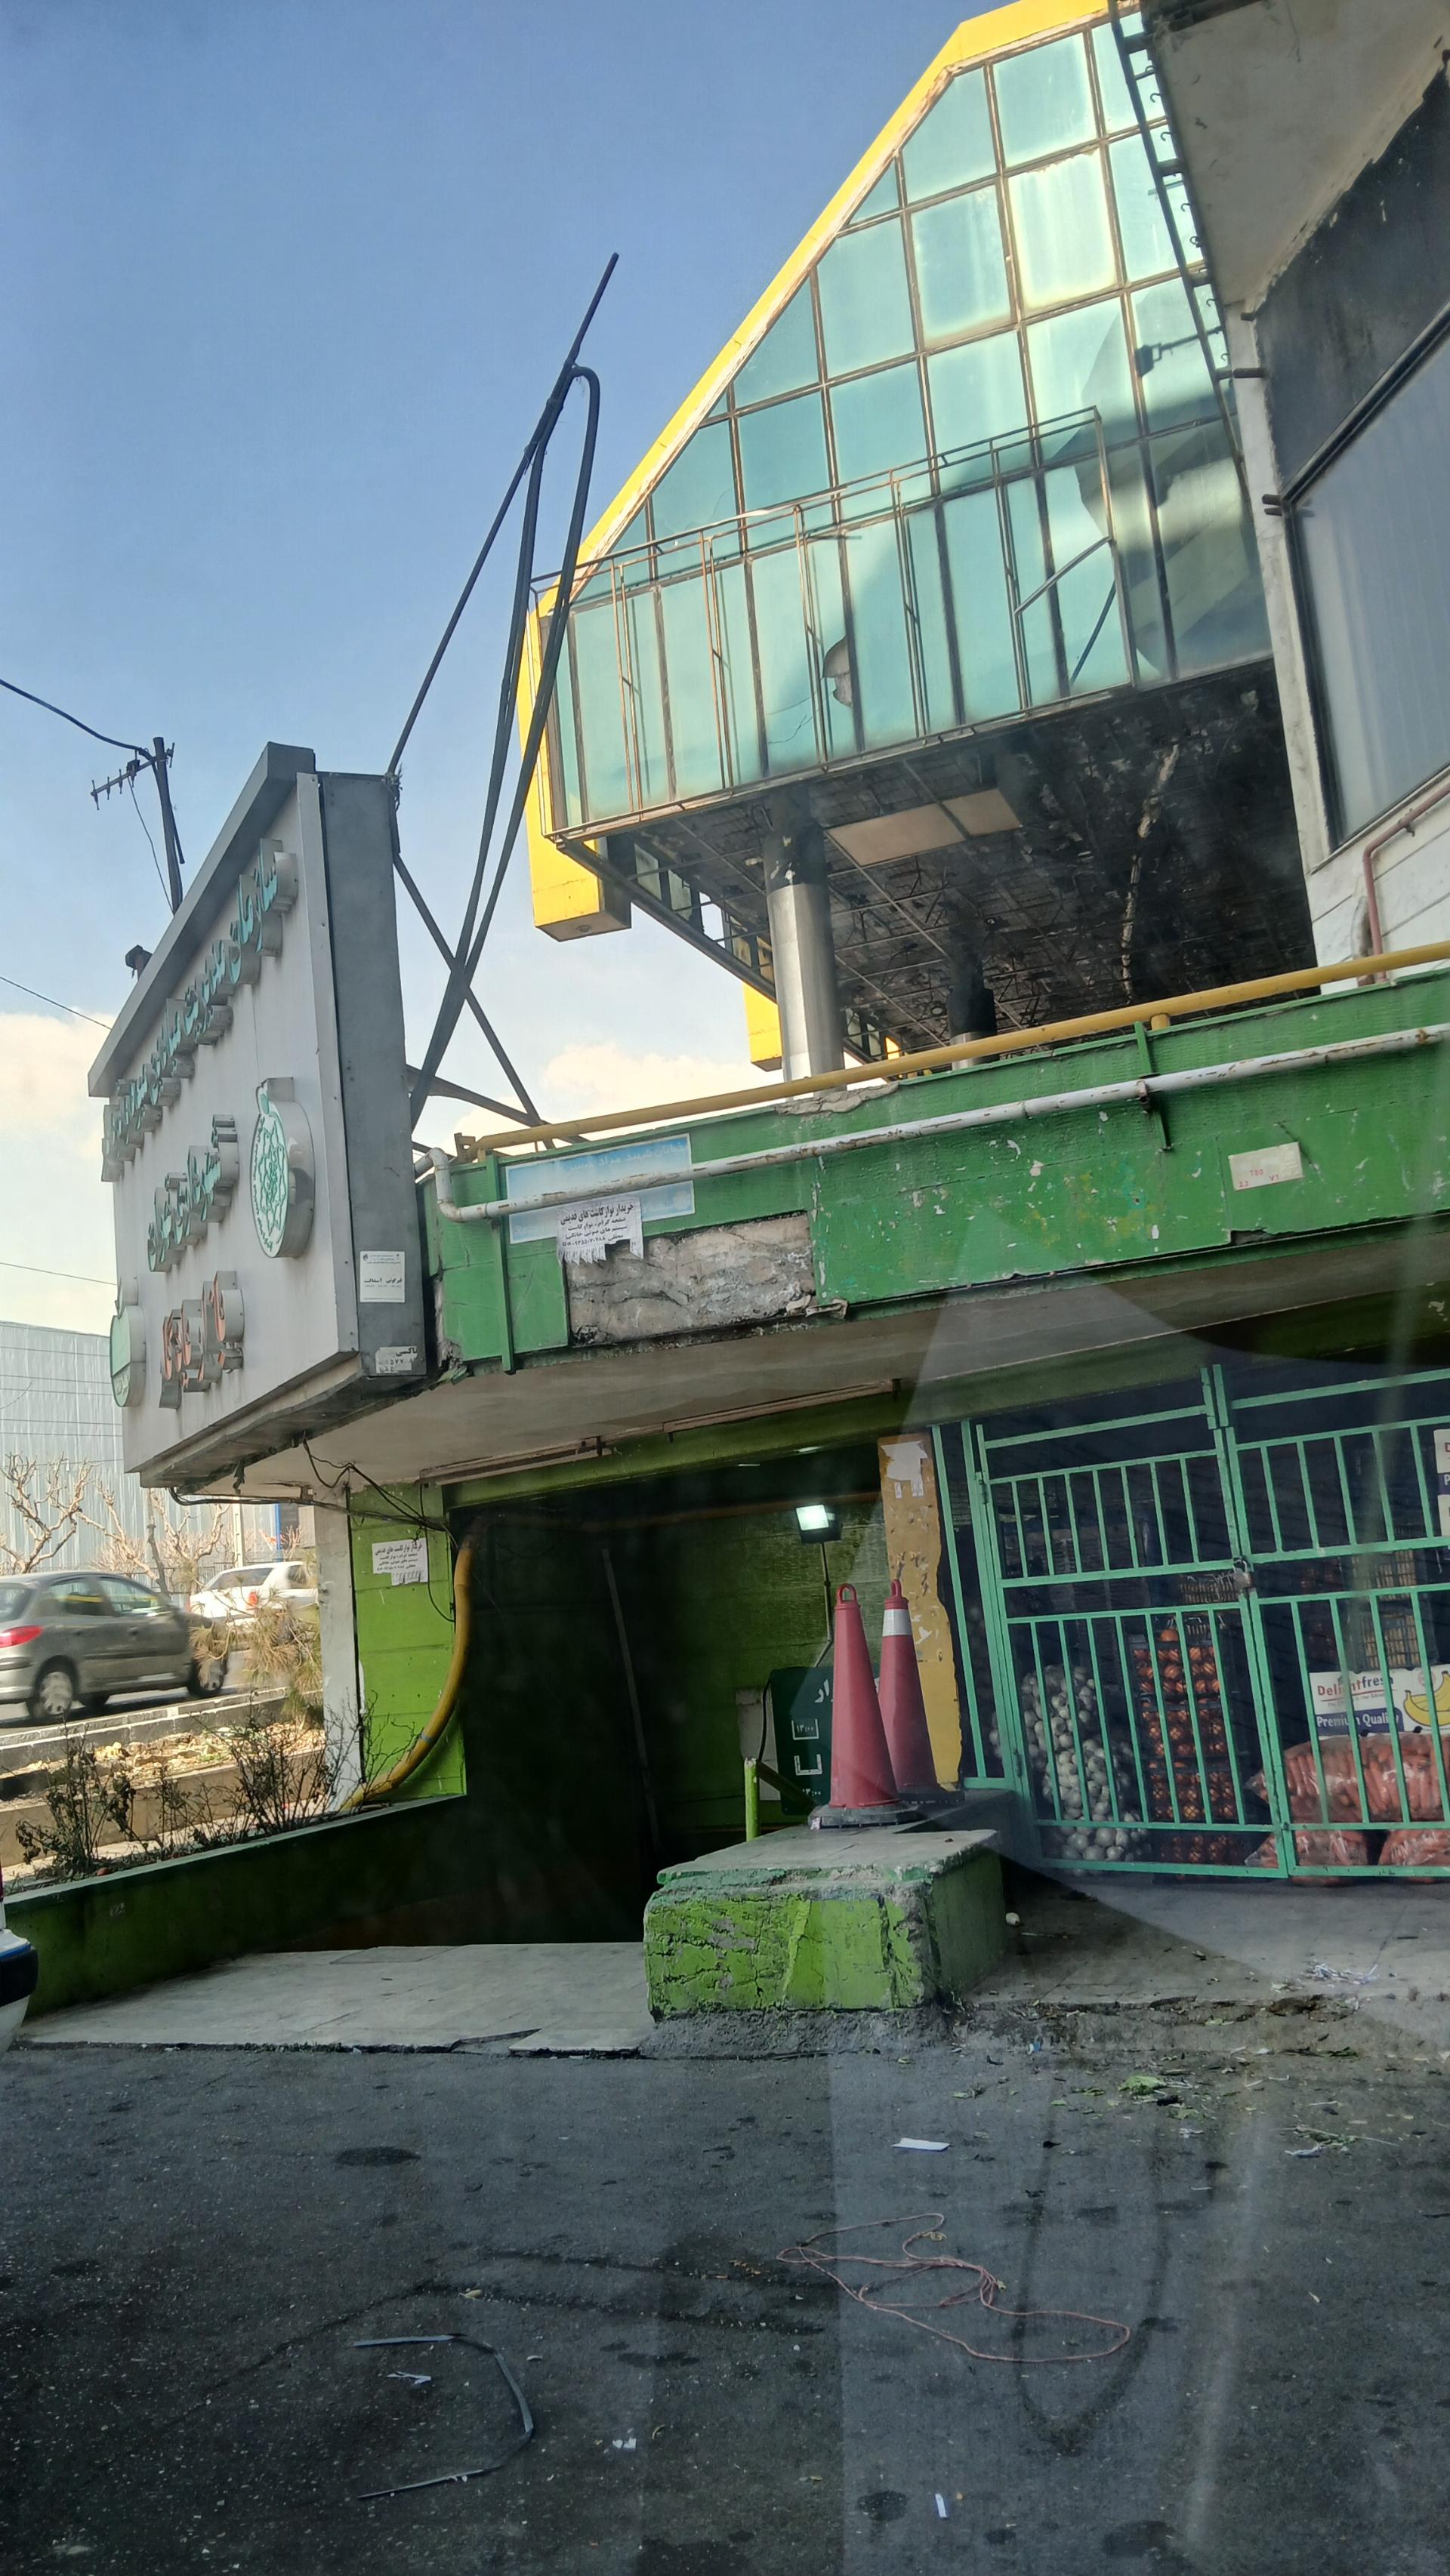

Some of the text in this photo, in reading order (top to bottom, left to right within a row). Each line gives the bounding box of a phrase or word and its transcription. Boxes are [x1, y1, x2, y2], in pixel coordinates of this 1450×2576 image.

[229, 839, 278, 984] سازمان
[184, 938, 227, 1044] مدیریت
[147, 1172, 173, 1272] تهران
[560, 1203, 634, 1225] خریدار نوار کاست های قدیمی
